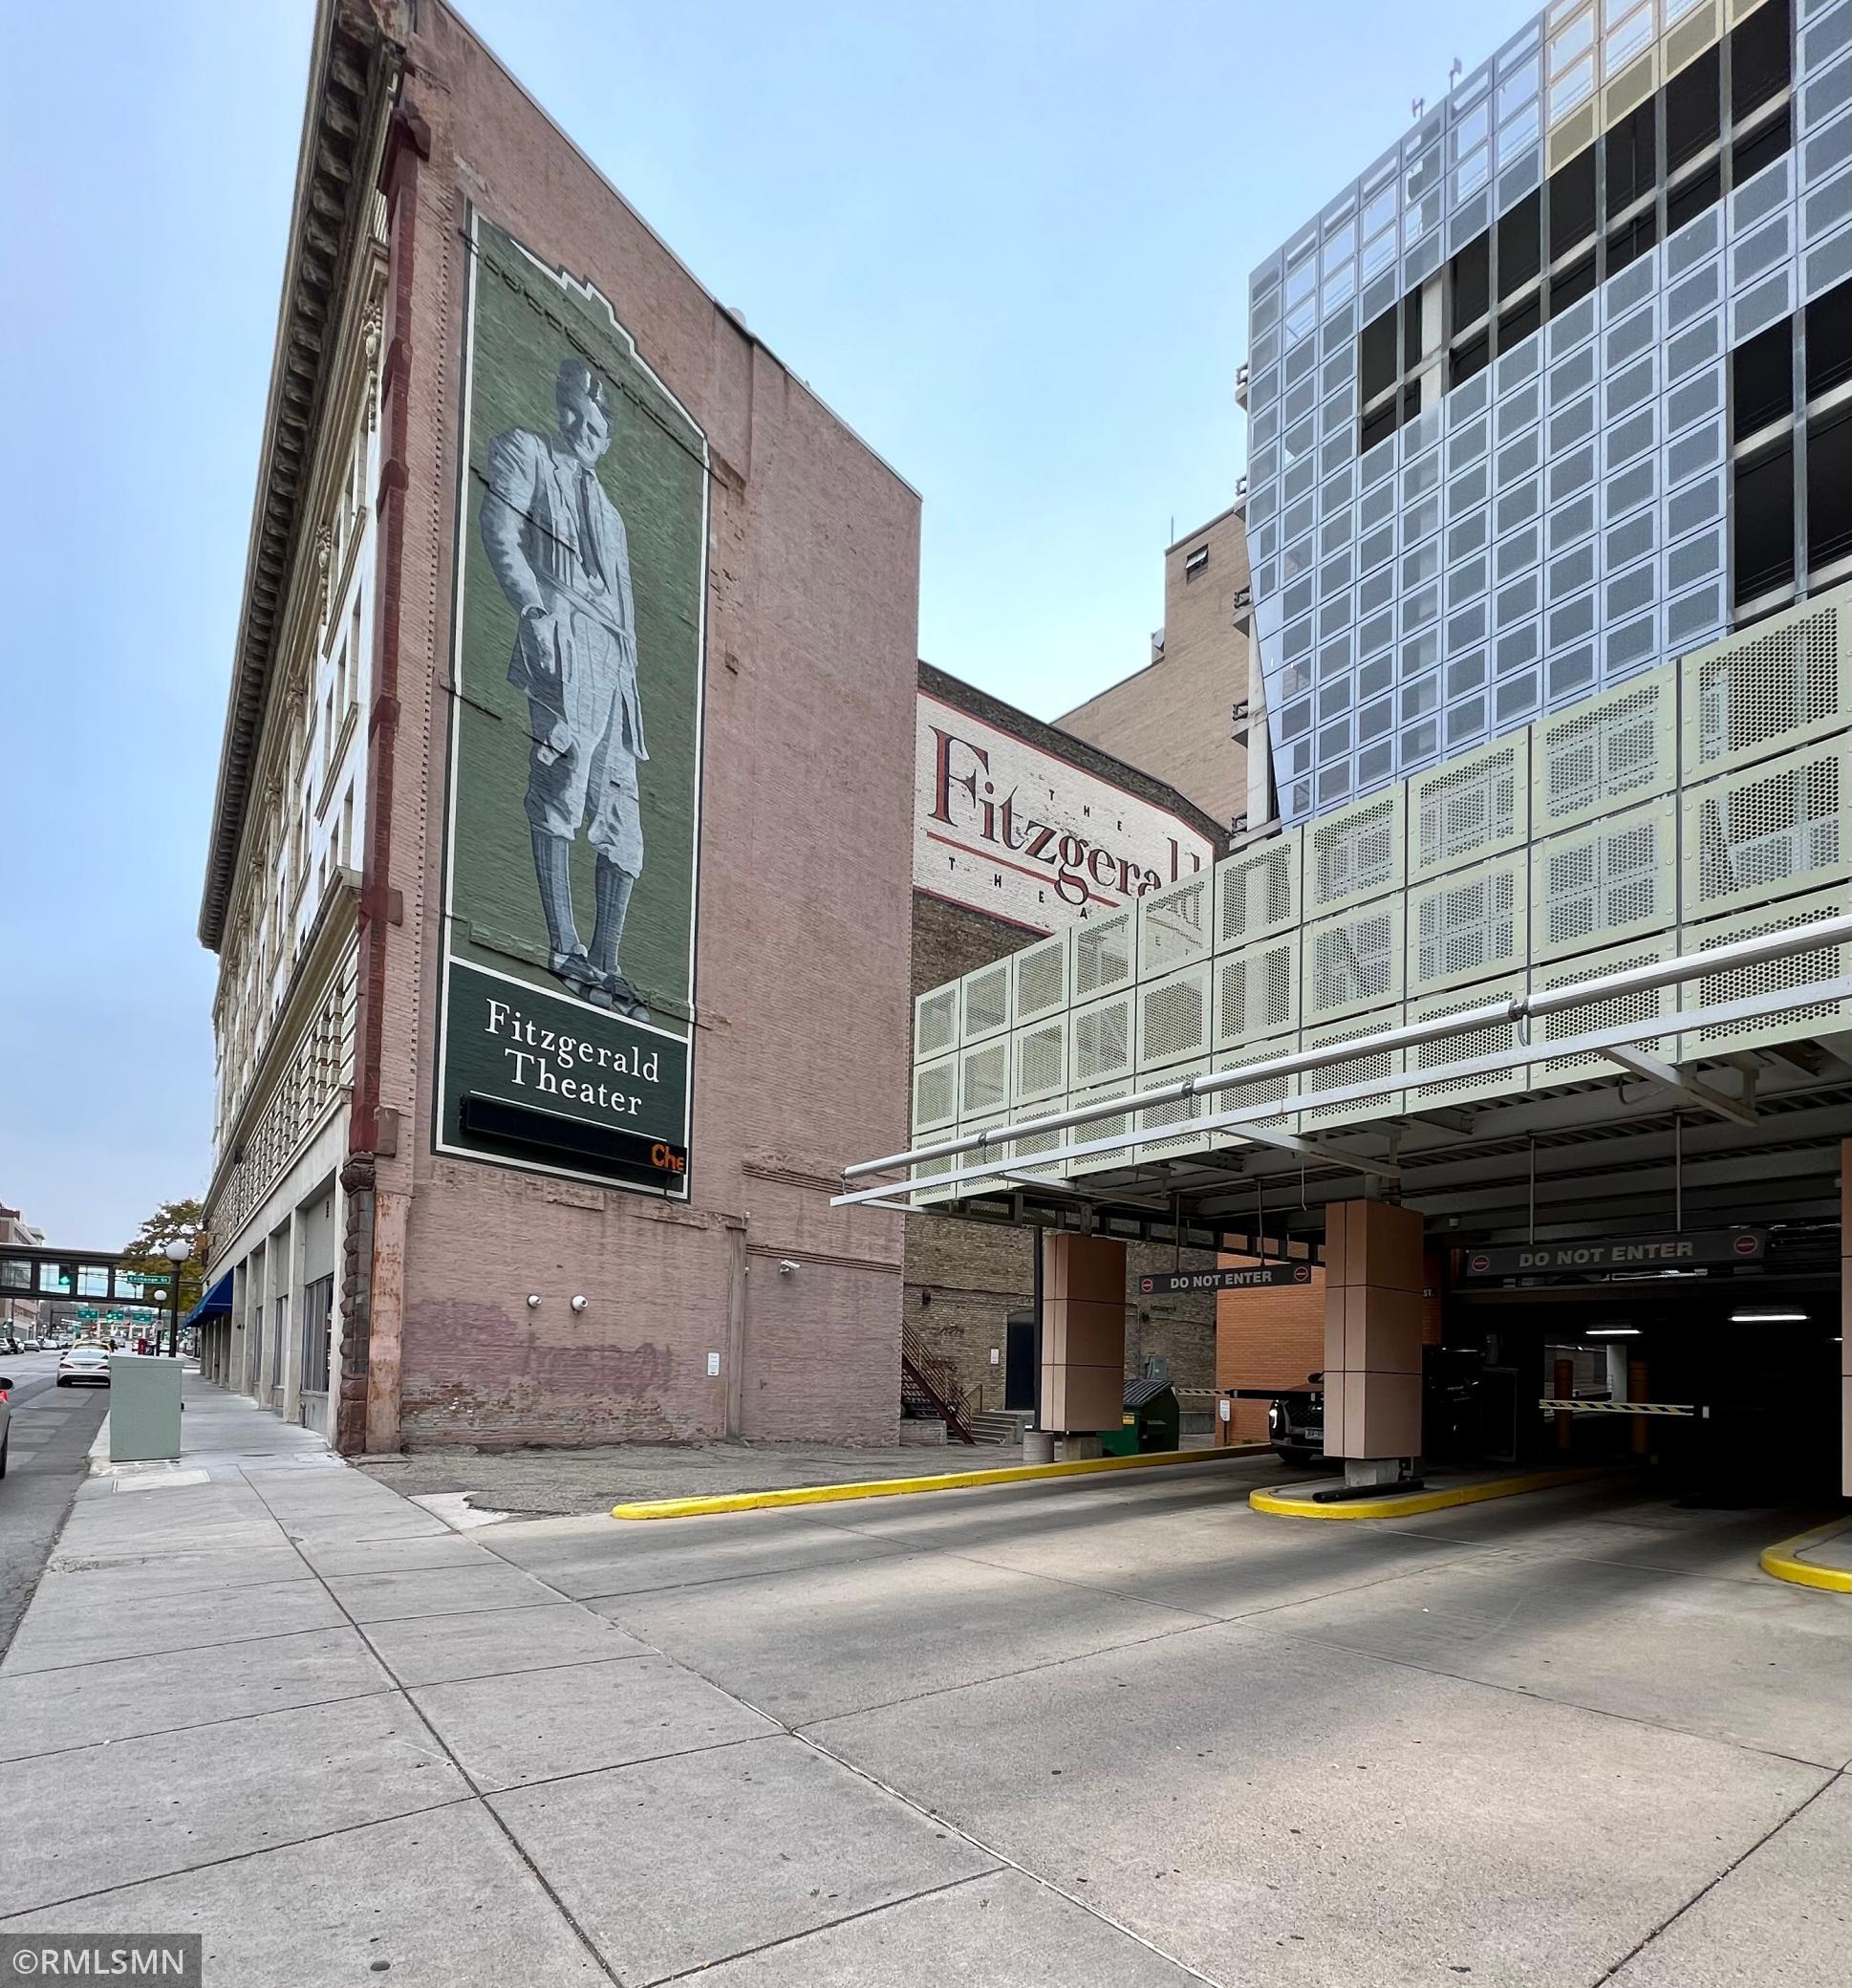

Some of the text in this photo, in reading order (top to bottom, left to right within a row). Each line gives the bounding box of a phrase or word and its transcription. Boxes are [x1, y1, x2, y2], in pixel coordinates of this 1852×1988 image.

[484, 998, 659, 1083] Fitzgerald
[504, 1048, 643, 1116] Theater
[652, 1143, 685, 1172] Che
[1518, 1242, 1694, 1267] DO NOT ENTER
[1170, 1270, 1273, 1289] DO NOT ENTER
